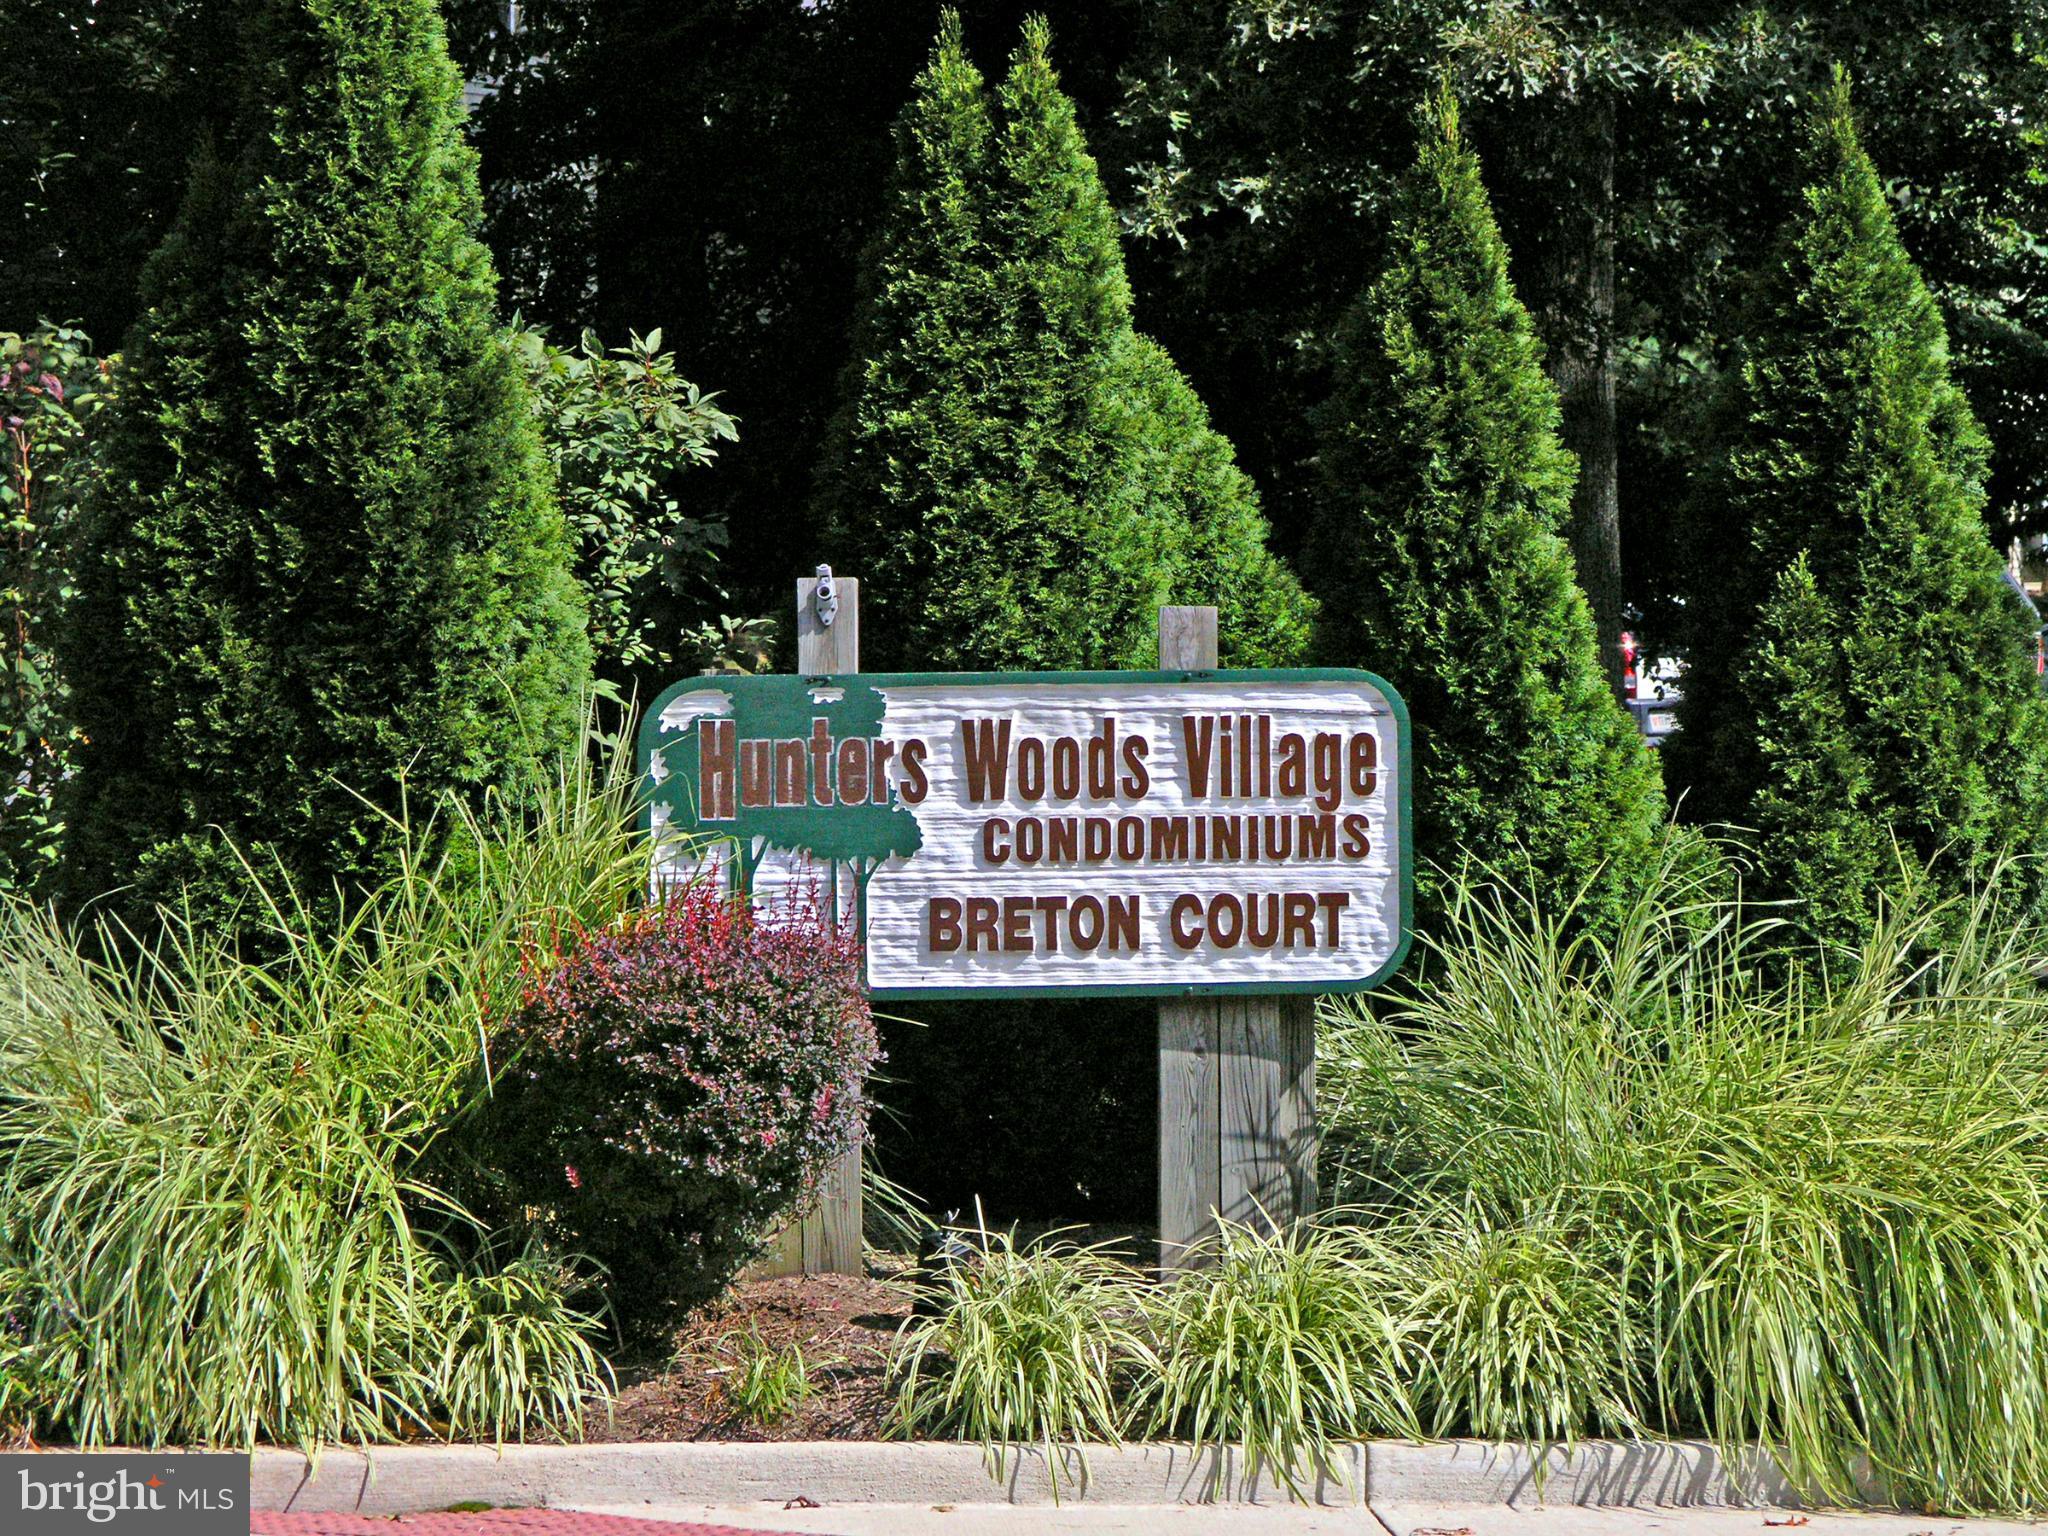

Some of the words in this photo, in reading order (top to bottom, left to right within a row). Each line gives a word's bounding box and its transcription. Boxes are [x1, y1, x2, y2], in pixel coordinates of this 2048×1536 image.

[698, 717, 929, 821] Hunters
[961, 717, 1150, 803] Woods
[1182, 715, 1378, 813] Village
[983, 813, 1371, 864] CONDOMINIUMS
[929, 895, 1141, 953] BRETON
[1170, 892, 1350, 951] COURT
